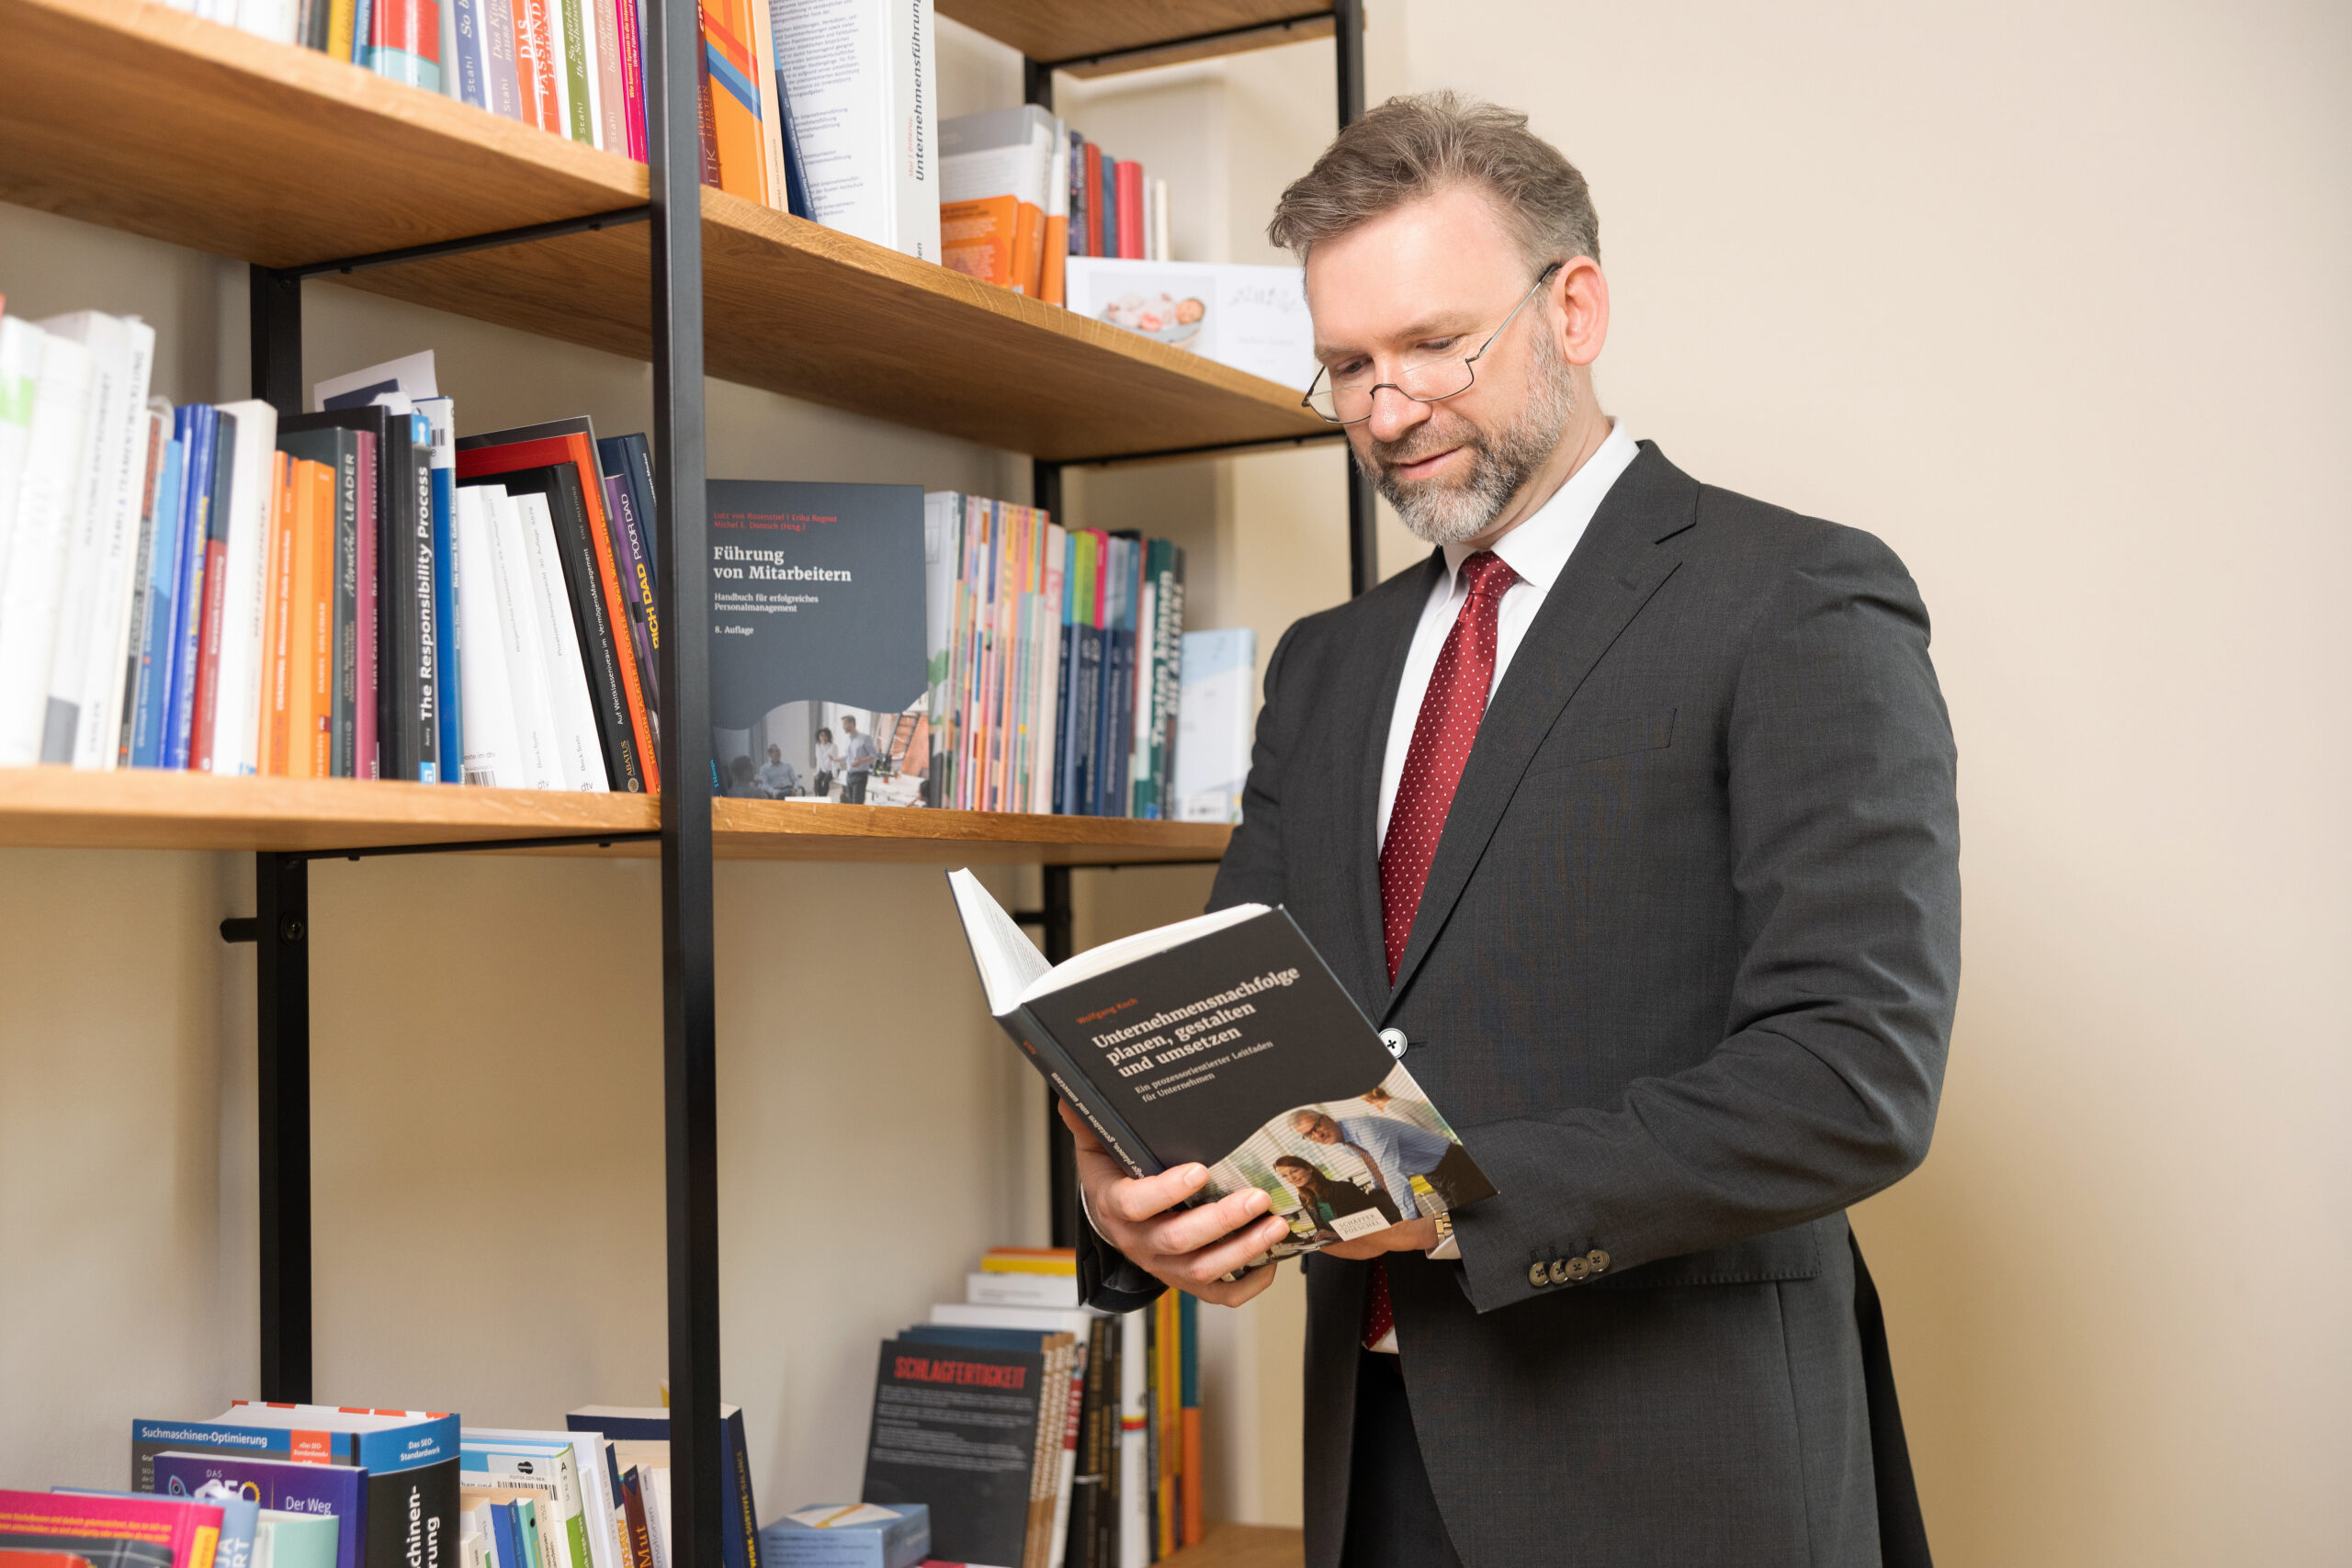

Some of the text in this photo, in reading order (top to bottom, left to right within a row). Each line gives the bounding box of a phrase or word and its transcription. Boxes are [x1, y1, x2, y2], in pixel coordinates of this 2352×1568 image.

[459, 14, 472, 39] So
[517, 19, 533, 59] DAS
[604, 0, 616, 73] beziehungs
[492, 31, 503, 59] Das
[464, 56, 476, 93] Stahl
[576, 58, 584, 79] Ihr
[501, 78, 512, 111] Stahl
[577, 102, 586, 134] Stahl
[701, 85, 712, 137] LEISTEN
[608, 111, 618, 142] Stahl
[345, 453, 355, 521] LEADER
[417, 467, 430, 537] Process
[571, 485, 582, 523] ANLEITUNG
[747, 513, 785, 521] Rosenstiel
[578, 525, 586, 540] EINE
[714, 521, 739, 529] Michel
[620, 493, 660, 649] RICH DAD POOR DAD
[714, 546, 785, 566] Führung
[714, 566, 852, 582] von Mitarbeitern
[582, 548, 605, 636] VermögensManagement
[714, 592, 819, 604] Handbuch für erfolgreiches
[418, 544, 435, 679] Responsibility
[714, 604, 797, 614] Personalmanagement
[599, 508, 656, 764] HANSON LASATER LASATER Weil Worte wirken
[601, 637, 608, 649] im
[715, 626, 754, 636] 8. Auflage
[605, 649, 620, 710] Weltklasseniveau
[421, 684, 433, 720] The
[620, 739, 633, 777] ABATUS
[537, 779, 549, 789] dtv
[581, 782, 594, 792] dtv
[1091, 965, 1300, 1048] Unternehmensnachfolge
[1106, 1001, 1256, 1066] planen, gestalten
[1118, 1027, 1243, 1077] und umsetzen
[1135, 1041, 1274, 1094] Ein prozessorientierter Leitfaden
[1051, 1072, 1080, 1102] umsetzen
[1142, 1072, 1216, 1102] für Unternehmen
[1076, 1101, 1091, 1116] und
[1088, 1114, 1115, 1143] gestalten
[1339, 1213, 1376, 1229] SCHÄFFER
[1343, 1220, 1381, 1235] POESCHEL
[893, 1356, 1028, 1390] SCHLAGFERTIGKEIT
[141, 1427, 268, 1449] Suchmaschinen-Optimierung
[408, 1438, 435, 1450] Das SEO-
[400, 1446, 441, 1462] Standardwerk
[206, 1469, 222, 1478] DAS
[286, 1495, 333, 1517] Der Weg
[406, 1485, 422, 1568] chinen-
[649, 1506, 662, 1568] motionen
[635, 1525, 652, 1568] Mut
